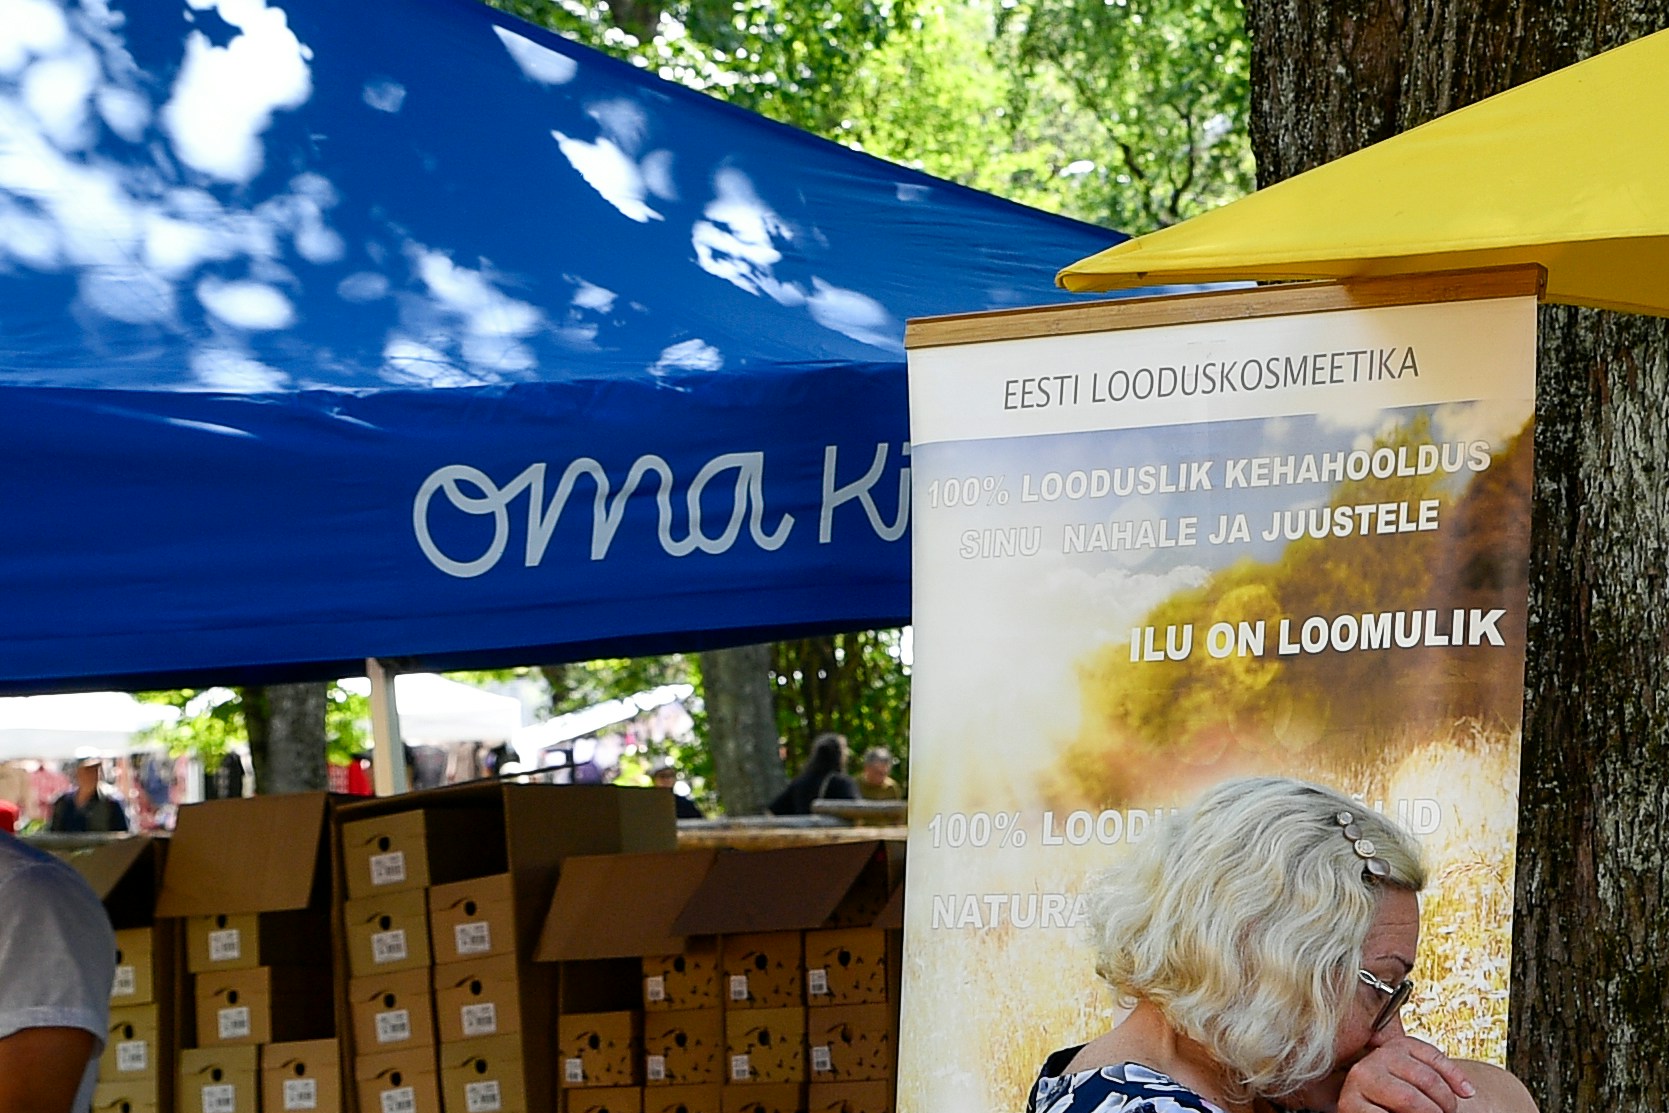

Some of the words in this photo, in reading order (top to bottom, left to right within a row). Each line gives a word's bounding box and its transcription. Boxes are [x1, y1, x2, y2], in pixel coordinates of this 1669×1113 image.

[1004, 374, 1079, 410] EESTI
[1091, 346, 1420, 403] LOODUSKOSMEETIKA
[927, 475, 1010, 509] 100%
[1020, 460, 1214, 503] LOODUSLIK
[1225, 440, 1492, 489] KEHAHOOLDUS
[413, 451, 795, 578] oma
[959, 526, 1042, 559] SINU
[1062, 516, 1199, 555] NAHALE
[1208, 513, 1251, 545] JA
[1262, 499, 1440, 542] JUUSTELE
[1129, 623, 1193, 662] ILU
[1206, 620, 1266, 658] ON
[1277, 609, 1507, 656] LOOMULIK
[927, 811, 1028, 849] 100%
